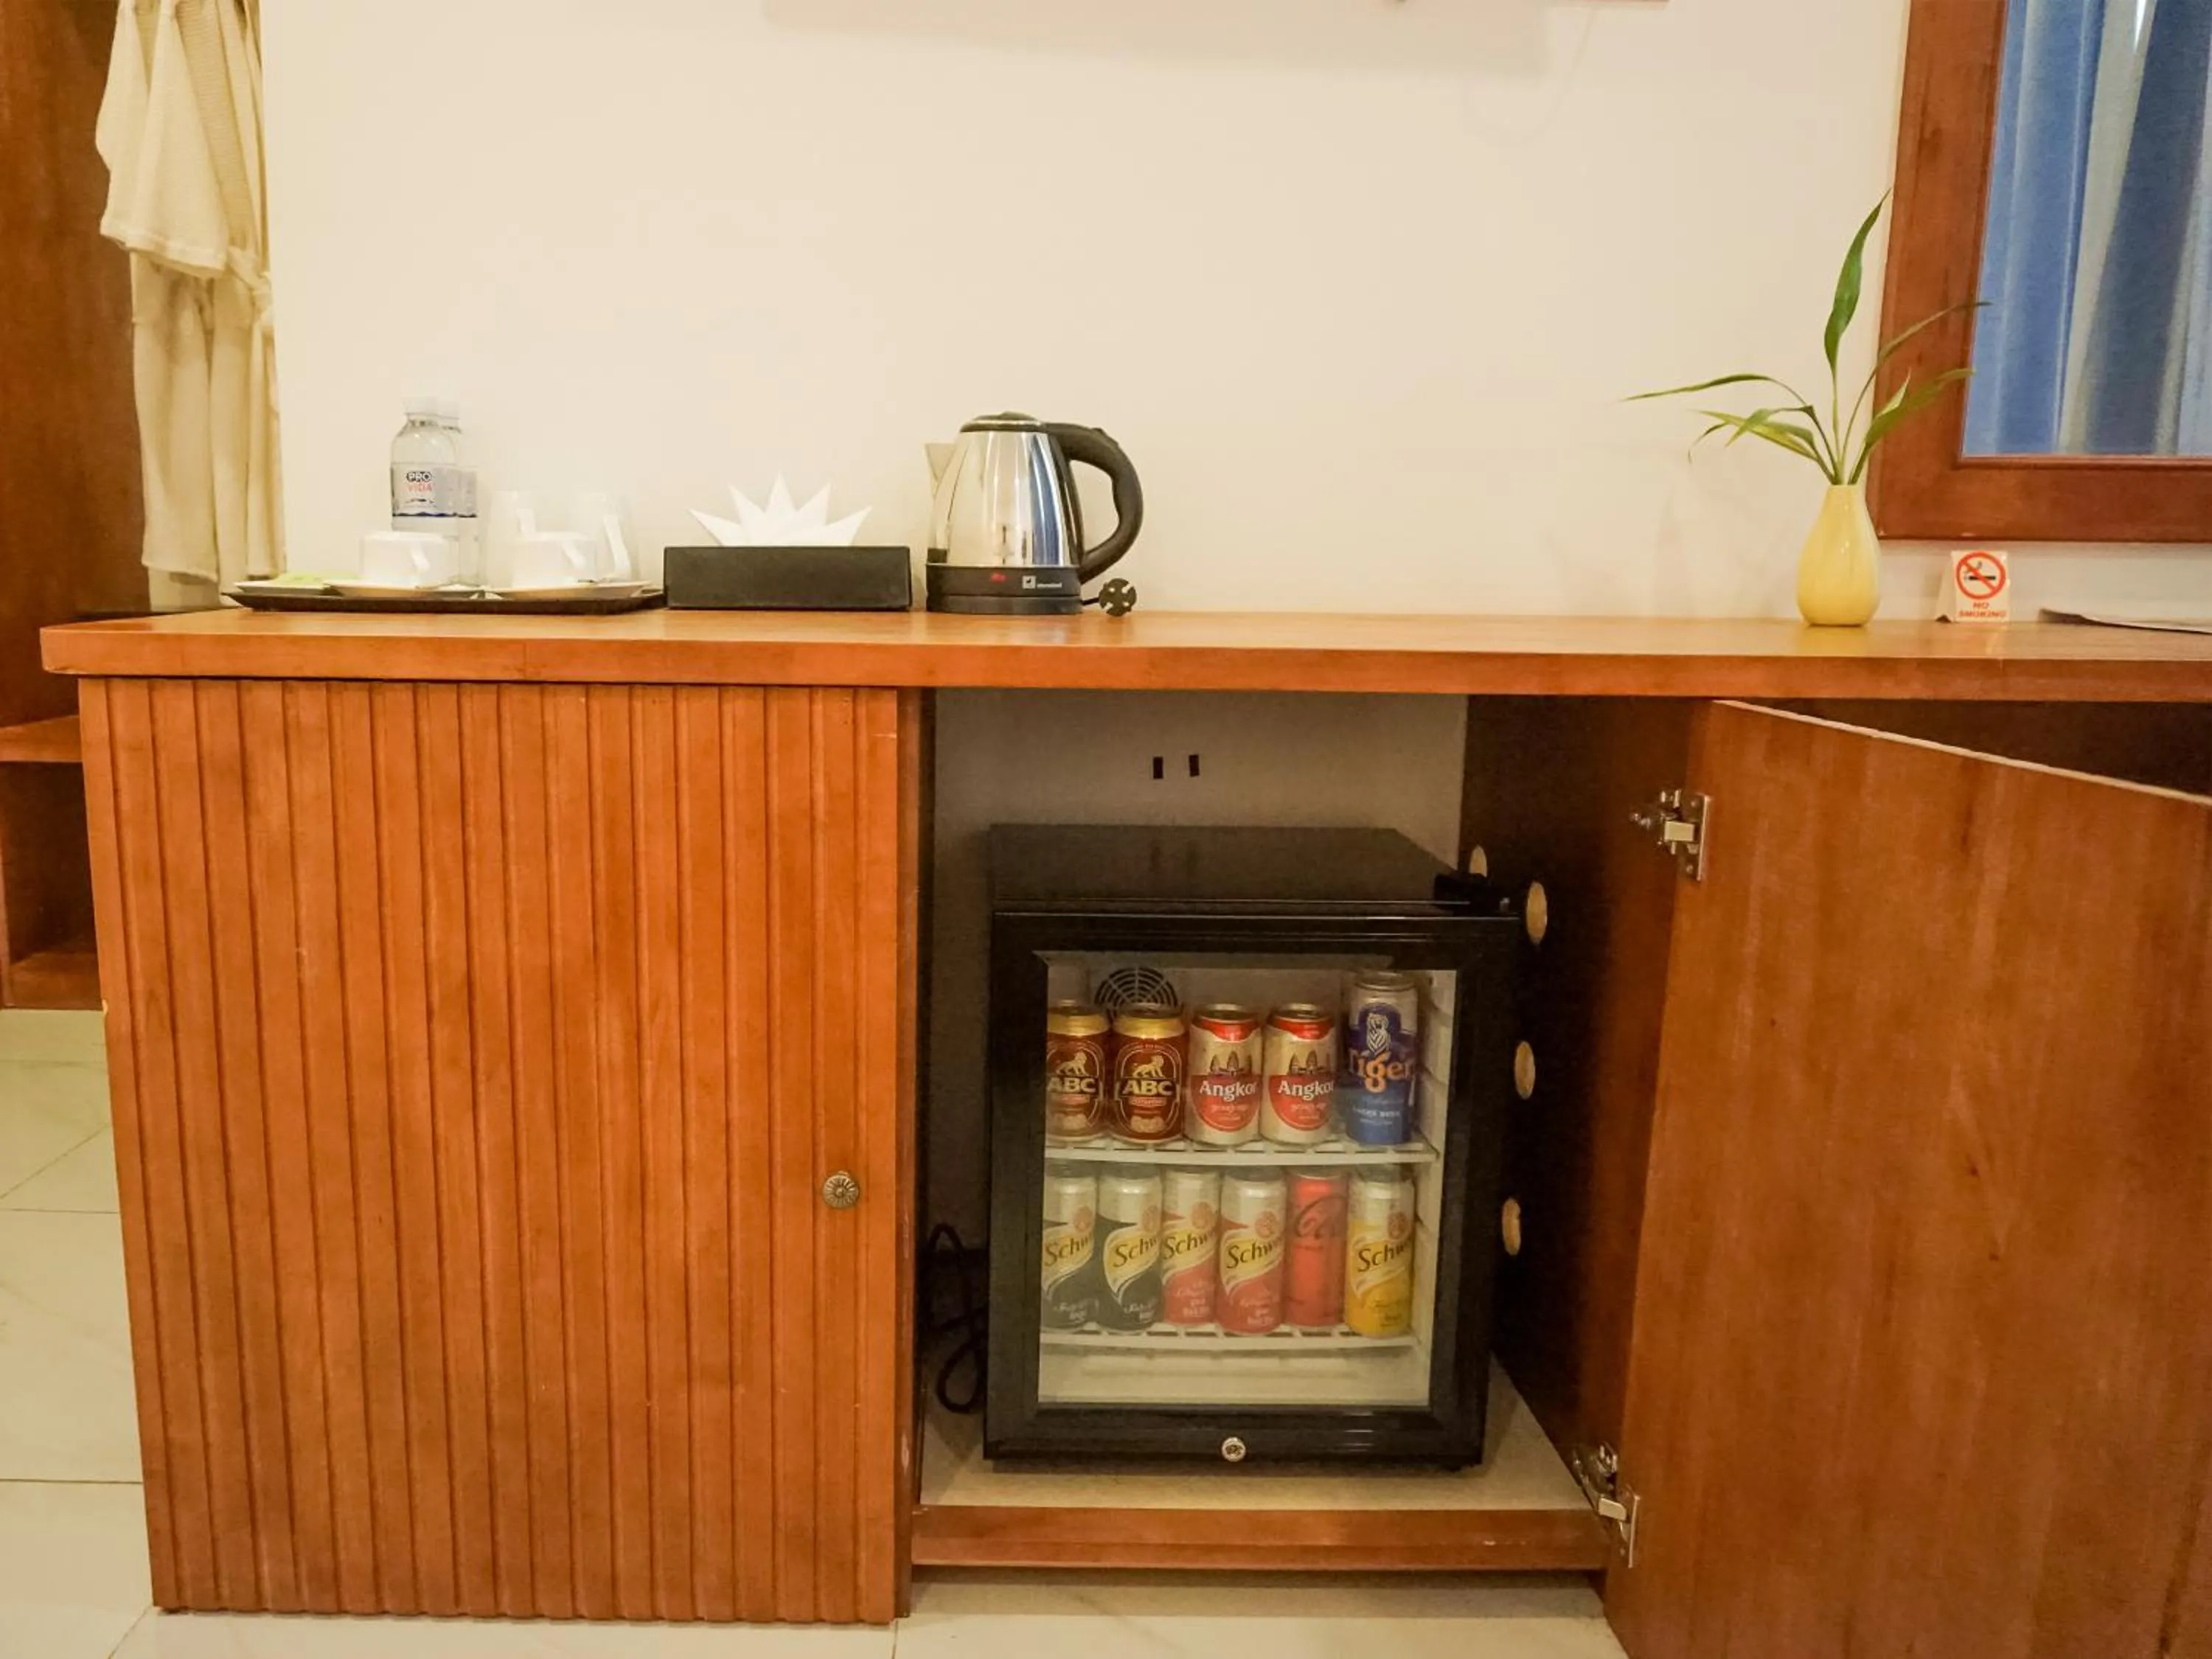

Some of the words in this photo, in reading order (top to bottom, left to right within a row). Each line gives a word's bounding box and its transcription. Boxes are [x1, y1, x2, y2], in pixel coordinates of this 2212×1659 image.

[407, 471, 432, 481] PRO
[1046, 1077, 1096, 1093] ABC
[1122, 1079, 1173, 1096] ABC
